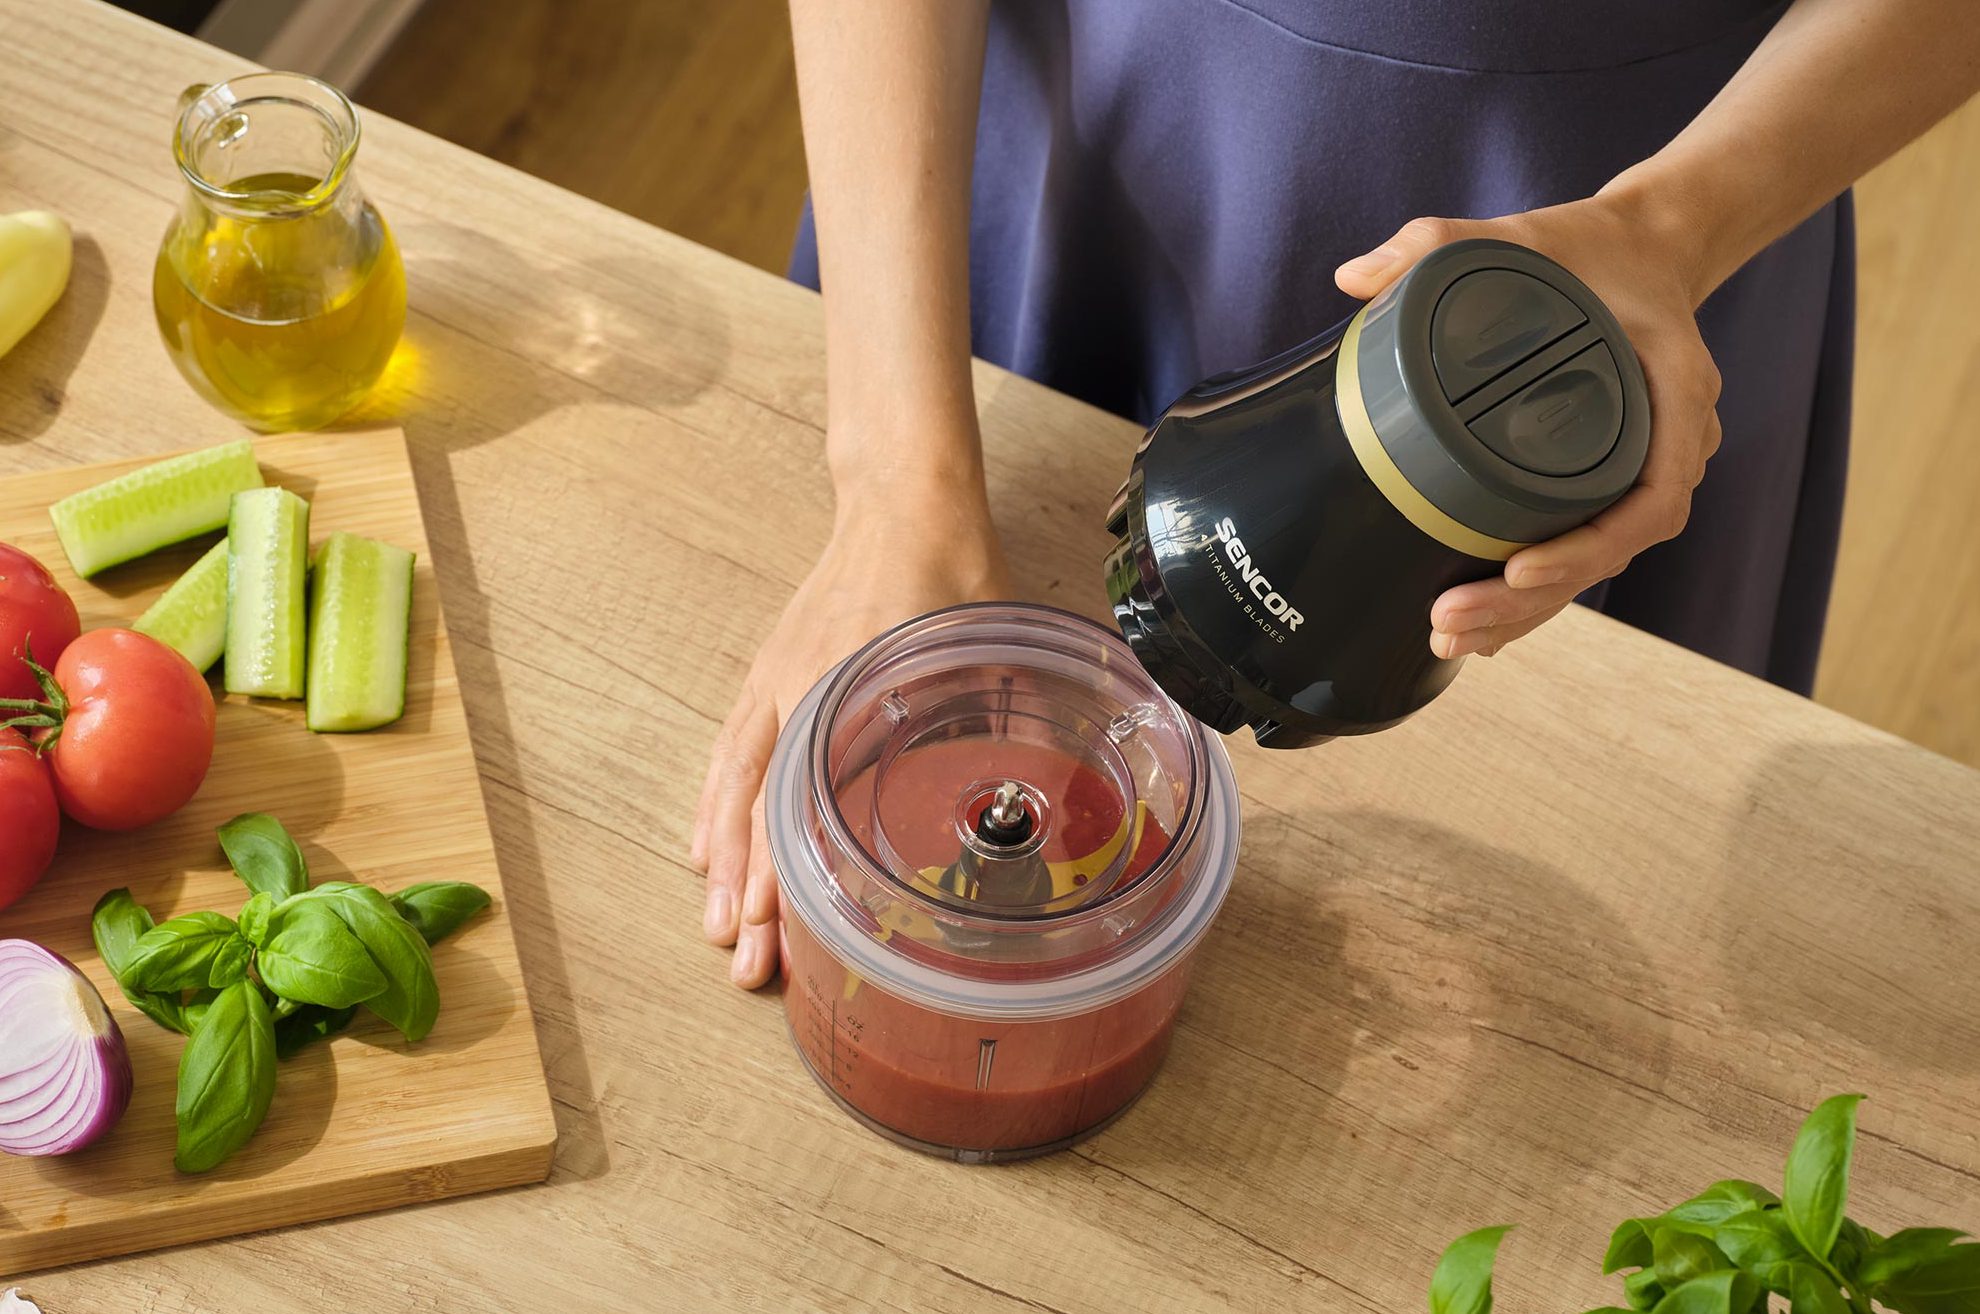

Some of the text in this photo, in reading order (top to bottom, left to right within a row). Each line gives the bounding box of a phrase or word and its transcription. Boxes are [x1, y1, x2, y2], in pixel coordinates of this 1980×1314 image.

[1205, 543, 1286, 644] TITANIUM BLADES
[1215, 516, 1305, 632] SENCOR
